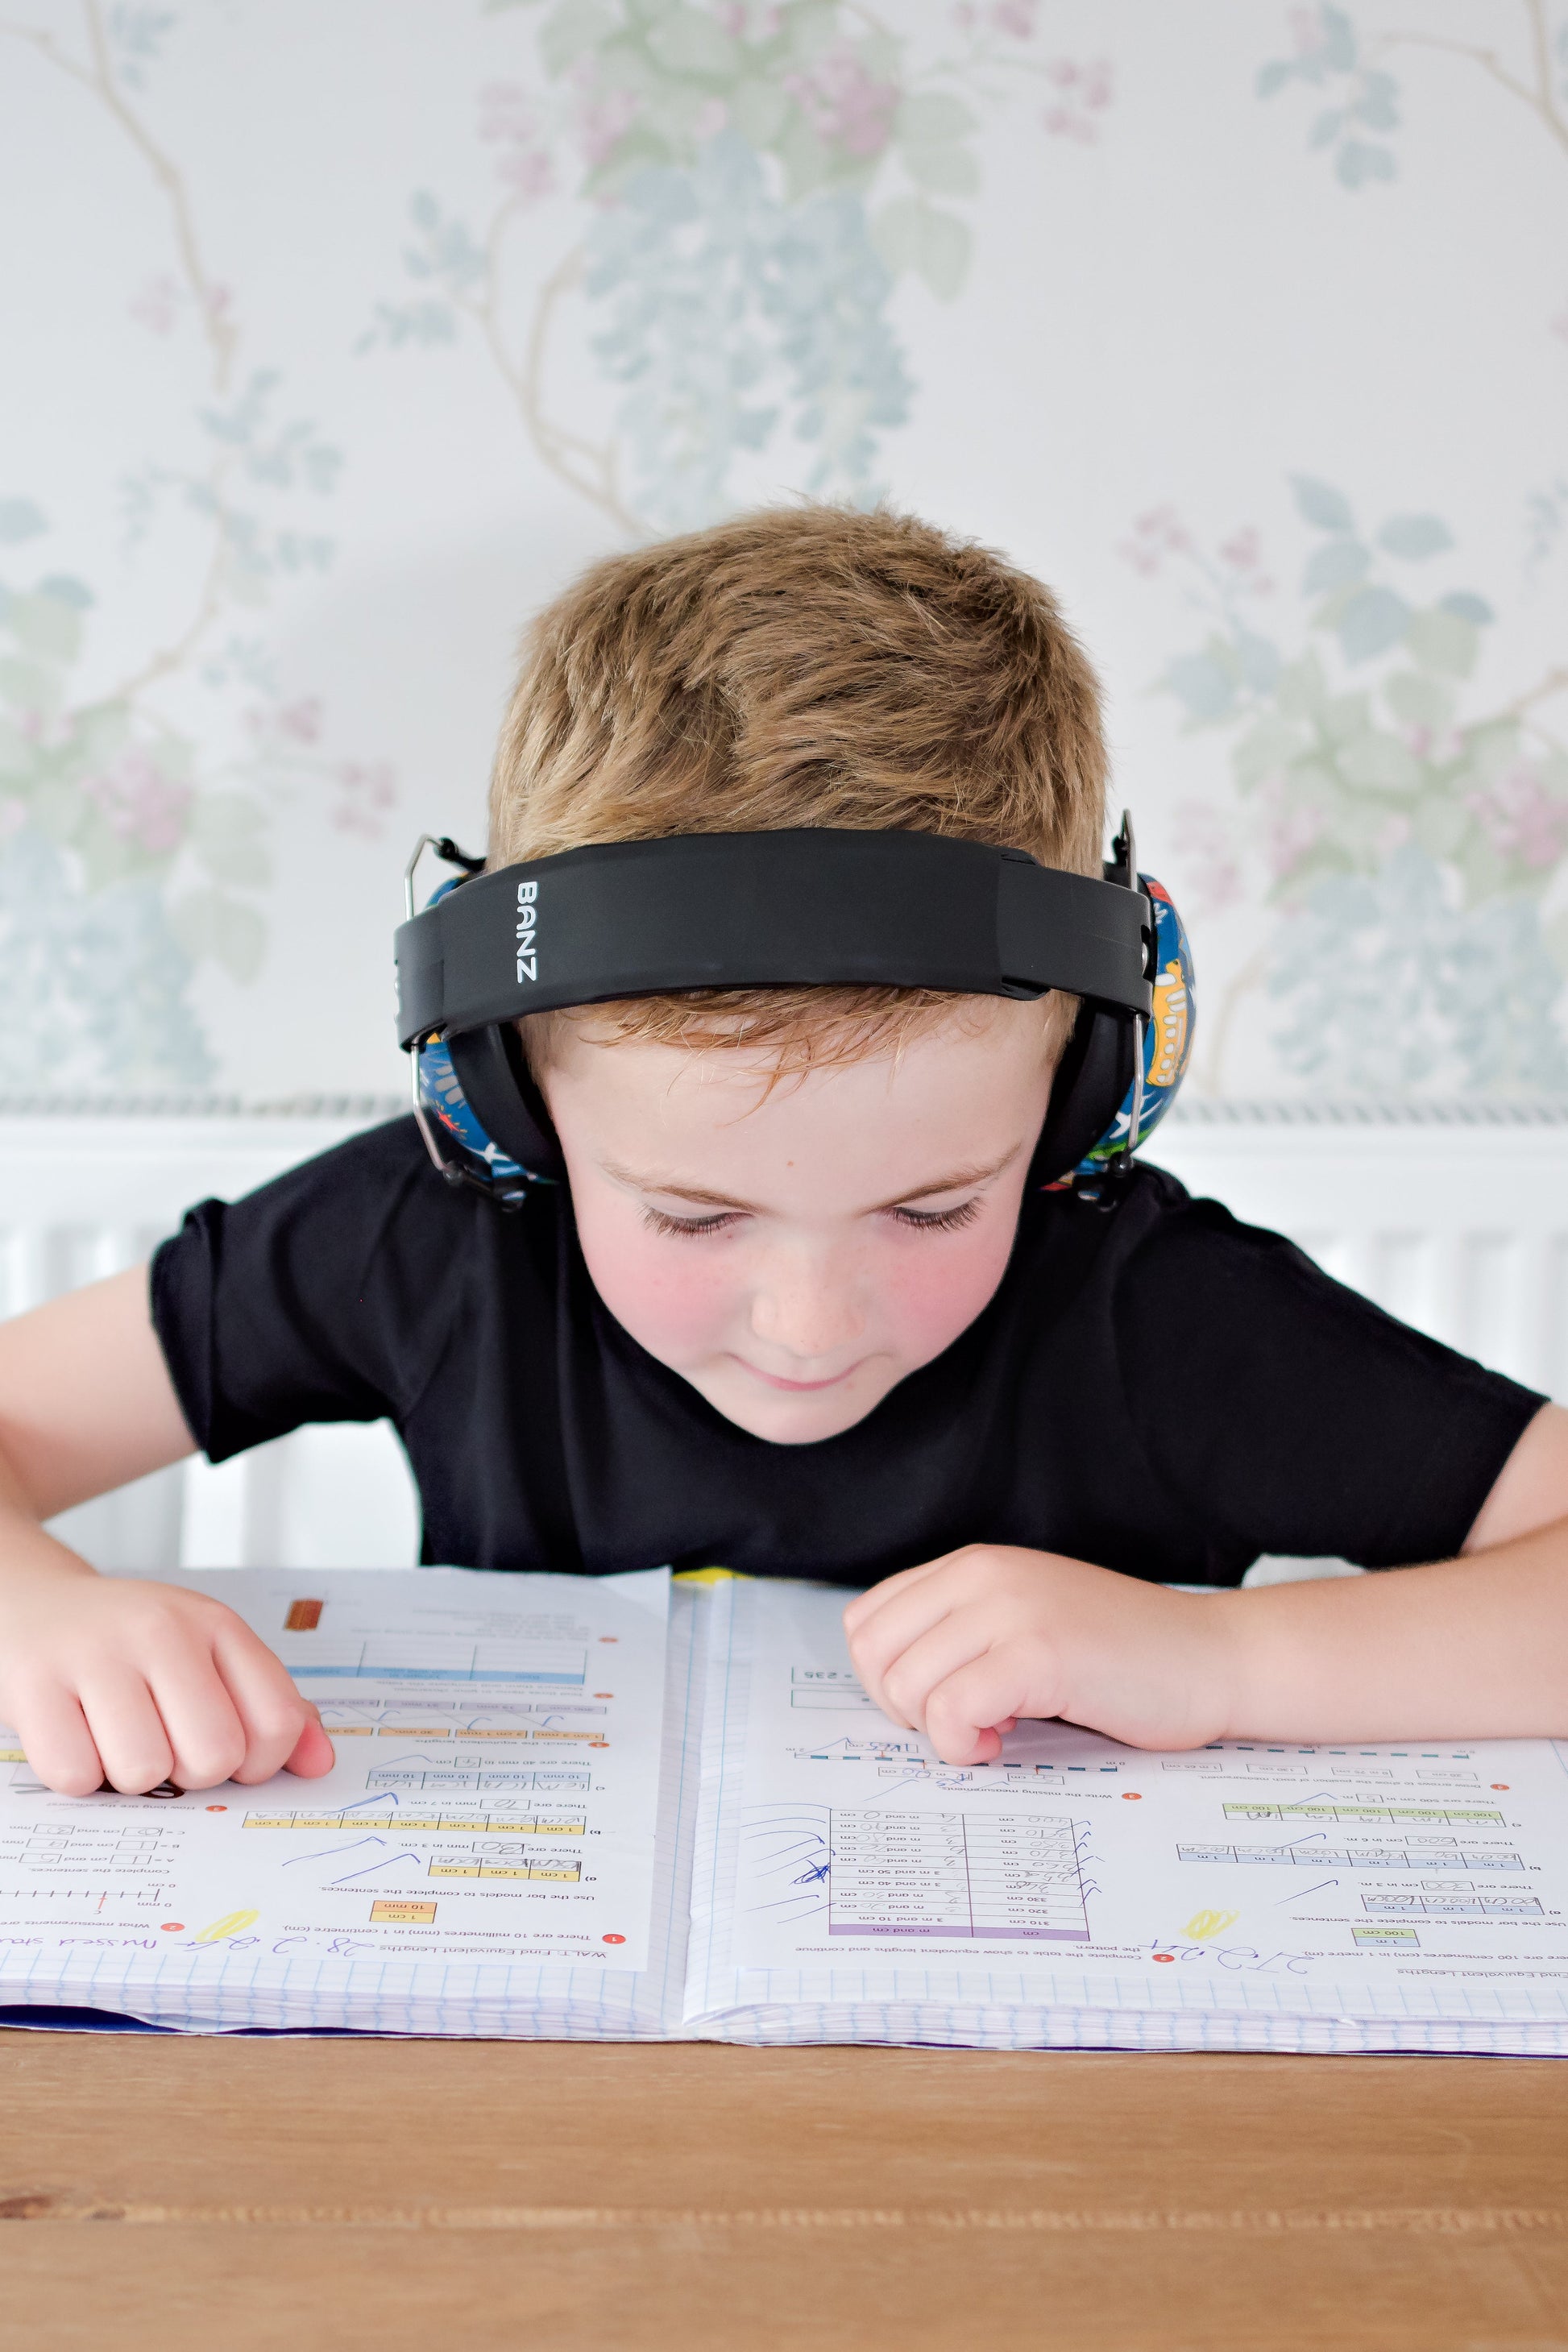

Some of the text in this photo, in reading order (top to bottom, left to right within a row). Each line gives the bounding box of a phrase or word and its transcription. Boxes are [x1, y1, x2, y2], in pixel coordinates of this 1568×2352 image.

[516, 881, 538, 984] BANZ
[805, 1671, 837, 1680] 235
[406, 1889, 459, 1897] complete
